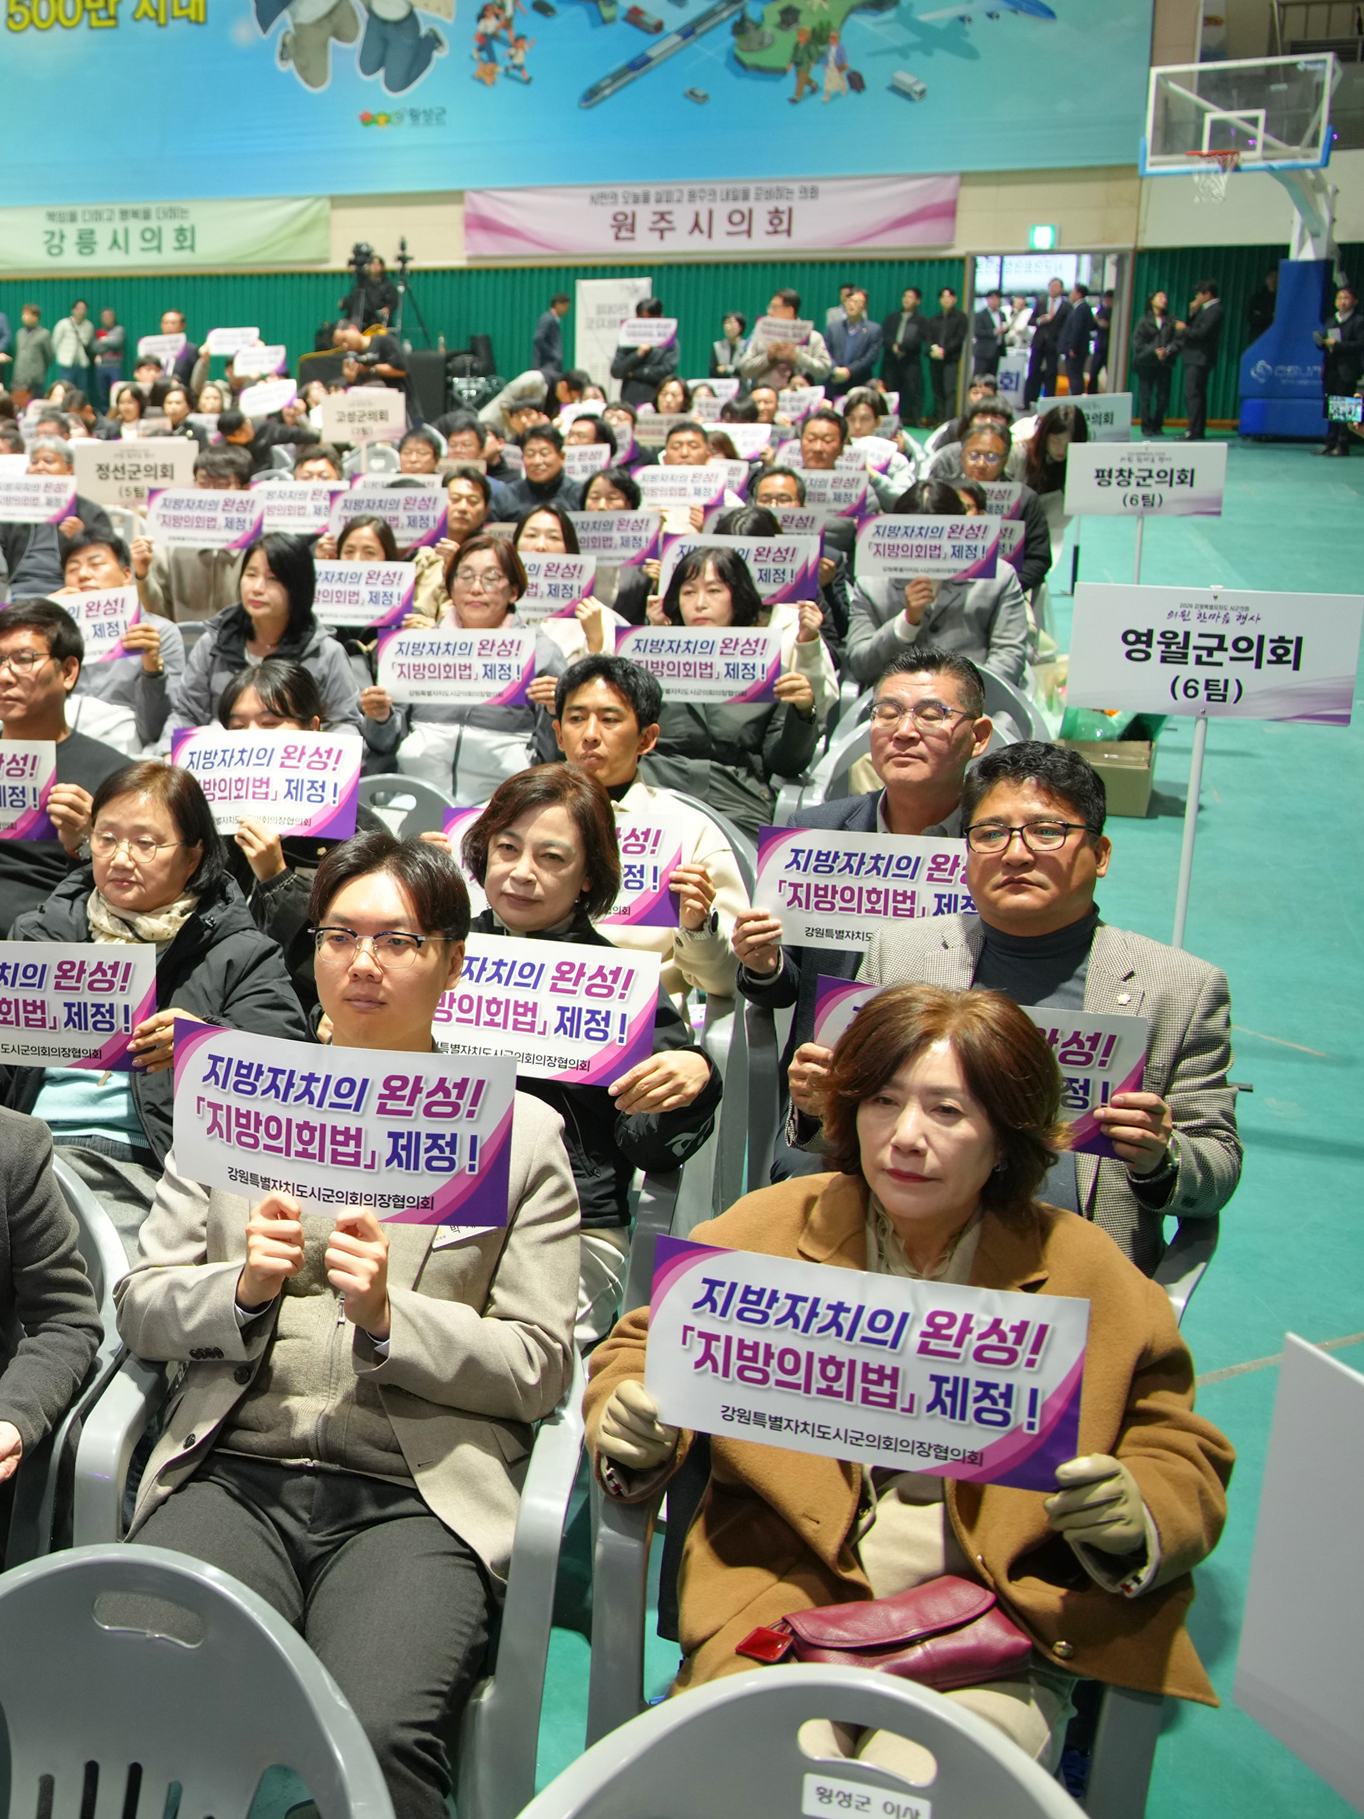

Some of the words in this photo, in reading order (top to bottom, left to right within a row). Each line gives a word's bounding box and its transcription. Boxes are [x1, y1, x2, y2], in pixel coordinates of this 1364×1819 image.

[609, 205, 795, 242] 원주시의회
[42, 224, 197, 257] 강릉시의회
[95, 462, 175, 481] 정선군의회
[641, 472, 689, 484] 지방자치의
[690, 472, 720, 484] 완성!
[1094, 467, 1195, 488] 평창군의회
[160, 497, 219, 512] 지방자치의
[221, 497, 255, 513] 완성!
[341, 496, 401, 512] 지방자치의
[402, 496, 437, 512] 완성!
[1122, 493, 1163, 508] (6팀)
[616, 517, 649, 532] 완성!
[780, 514, 816, 530] 완성!
[872, 525, 945, 539] 지방자치의
[947, 524, 989, 540] 완성!
[753, 545, 797, 563] 완성!
[365, 570, 403, 586] 완성!
[544, 562, 584, 579] 완성!
[85, 597, 126, 620] 완성!
[394, 640, 473, 656] 지방자치의
[477, 639, 522, 657] 완성!
[632, 638, 716, 655] 지방자치의
[719, 637, 767, 656] 완성!
[1121, 628, 1304, 671] 영월군의회
[391, 662, 479, 681] 「지방의회법」
[1170, 675, 1244, 704] (6팀)
[187, 747, 275, 770] 지방자치의
[279, 745, 343, 771] 완성!
[785, 848, 921, 880] 지방자치의
[54, 960, 132, 992] 완성!
[462, 956, 545, 990] 자치의
[549, 961, 634, 999] 완성!
[202, 1054, 370, 1112] 지방자치의
[376, 1074, 486, 1119] 완성!
[197, 1096, 376, 1169] 「지방의회법」
[691, 1277, 910, 1350] 지방자치의
[916, 1310, 1050, 1369] 완성!
[681, 1325, 915, 1415] 「지방의회법」
[720, 1404, 984, 1468] 강원특별자치도시군의회의장협의회
[816, 1786, 872, 1812] 횡성군
